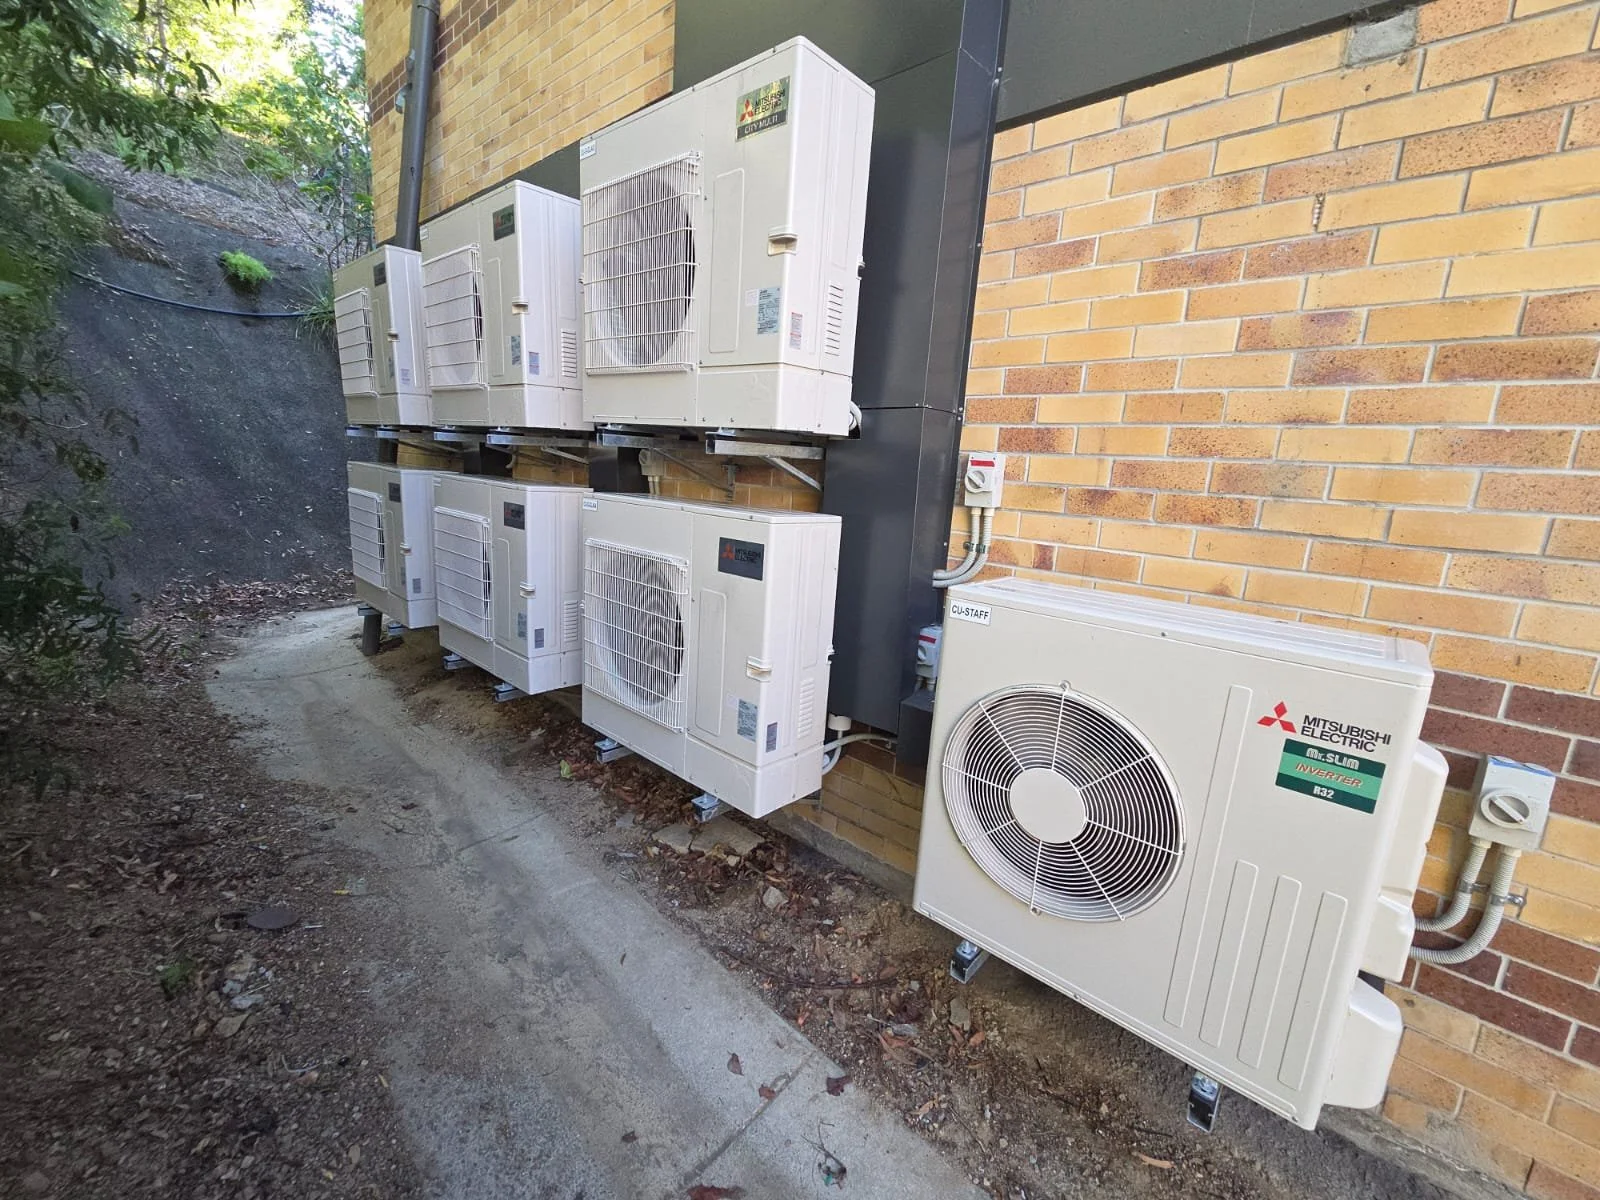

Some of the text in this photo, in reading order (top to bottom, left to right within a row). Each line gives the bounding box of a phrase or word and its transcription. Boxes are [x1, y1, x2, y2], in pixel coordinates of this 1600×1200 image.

[744, 114, 778, 133] CITY MULTI
[951, 604, 990, 620] CU-STAFF
[1300, 726, 1377, 753] ELECTRIC
[1303, 714, 1392, 745] MITSUBISHI
[1295, 761, 1363, 788] INVERTER
[1313, 785, 1335, 799] R32
